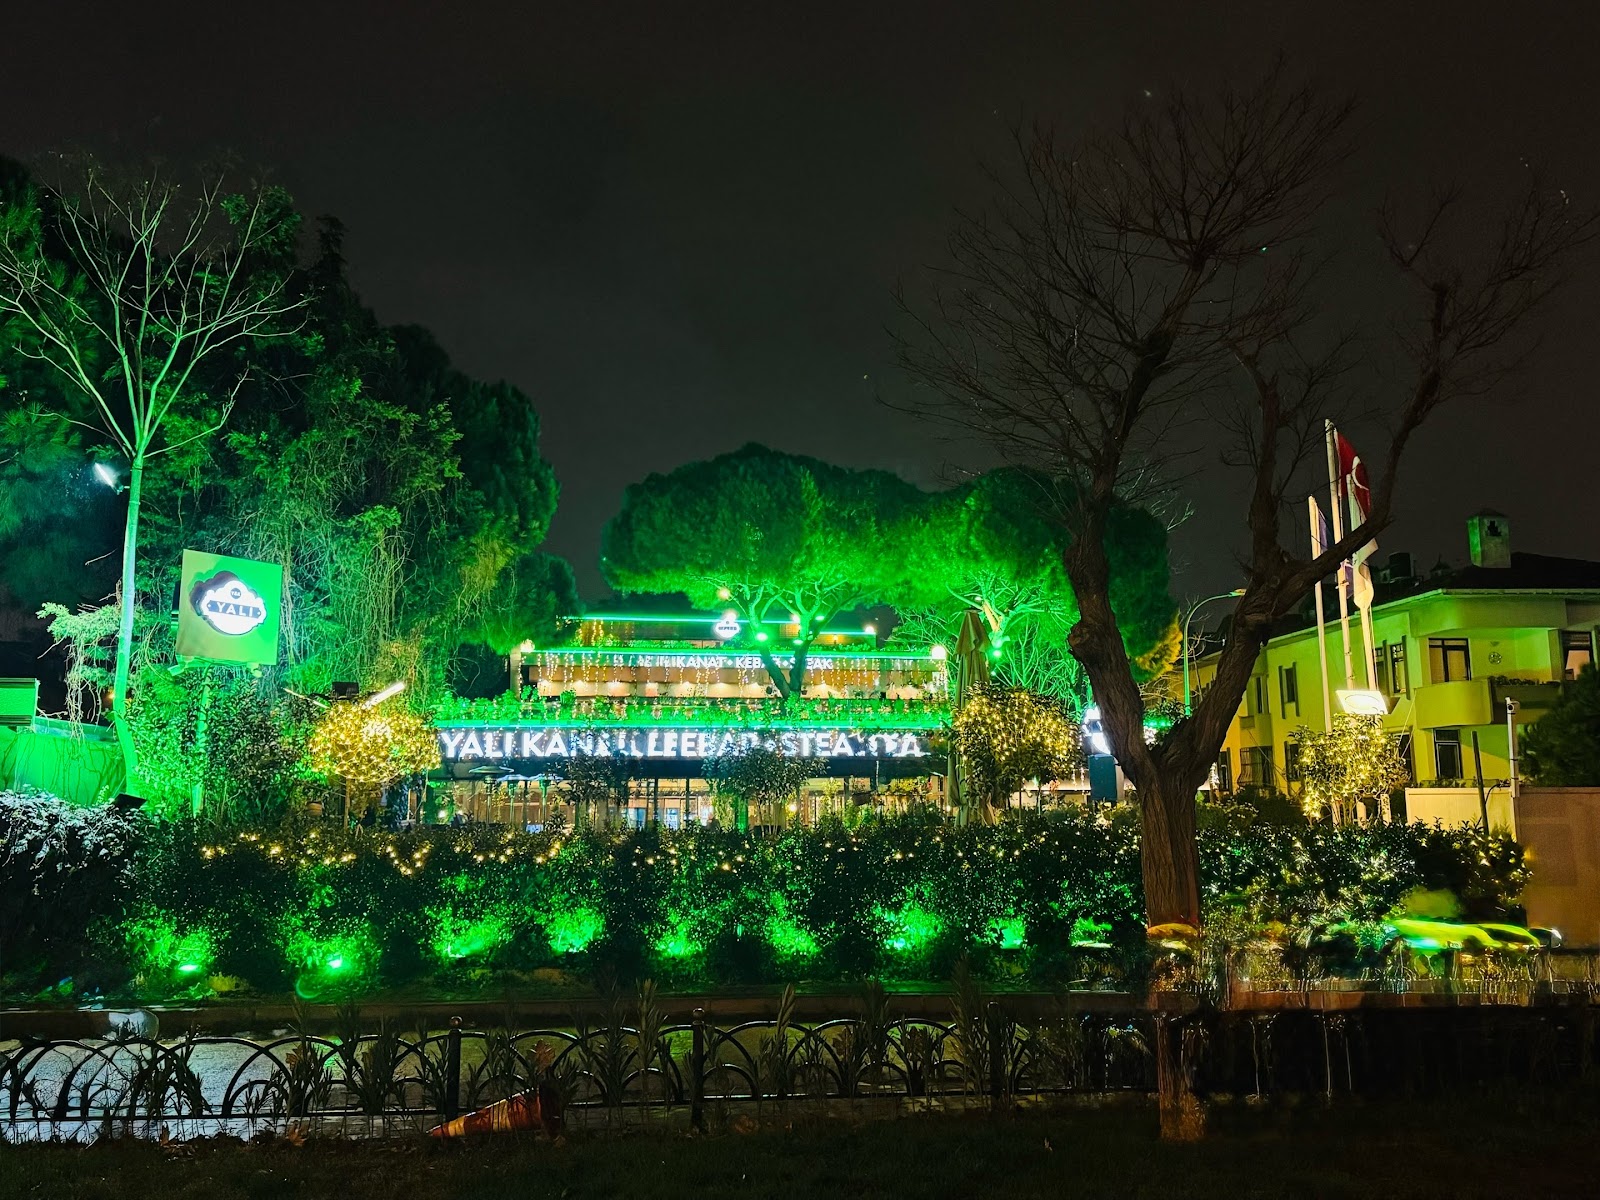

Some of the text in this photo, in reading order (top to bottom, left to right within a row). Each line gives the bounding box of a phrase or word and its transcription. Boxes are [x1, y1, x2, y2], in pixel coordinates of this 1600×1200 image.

[217, 602, 253, 617] YALI
[677, 656, 727, 668] KANAT
[789, 657, 833, 669] SEAK
[441, 732, 514, 758] YALI
